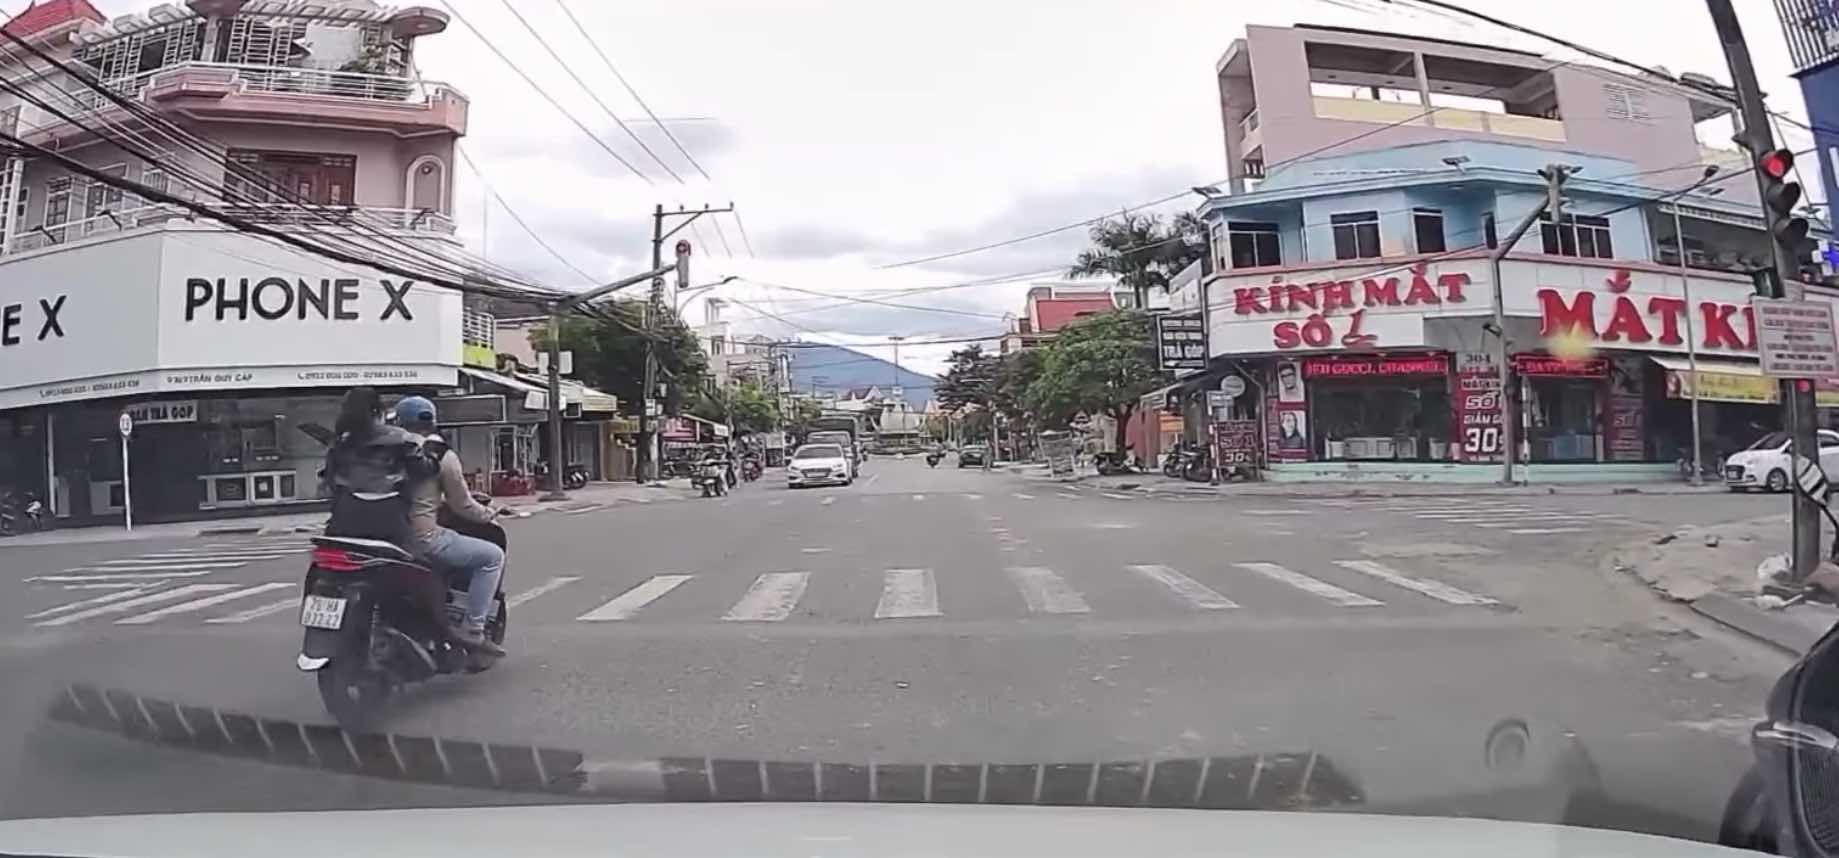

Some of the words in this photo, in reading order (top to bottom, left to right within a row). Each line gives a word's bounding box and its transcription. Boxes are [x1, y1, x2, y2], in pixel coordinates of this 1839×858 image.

[185, 277, 359, 322] PHONE
[379, 280, 414, 321] X
[1233, 276, 1356, 314] KÍNH
[1362, 264, 1471, 306] MẮT
[1537, 269, 1687, 346] MẮT
[38, 295, 67, 341] X
